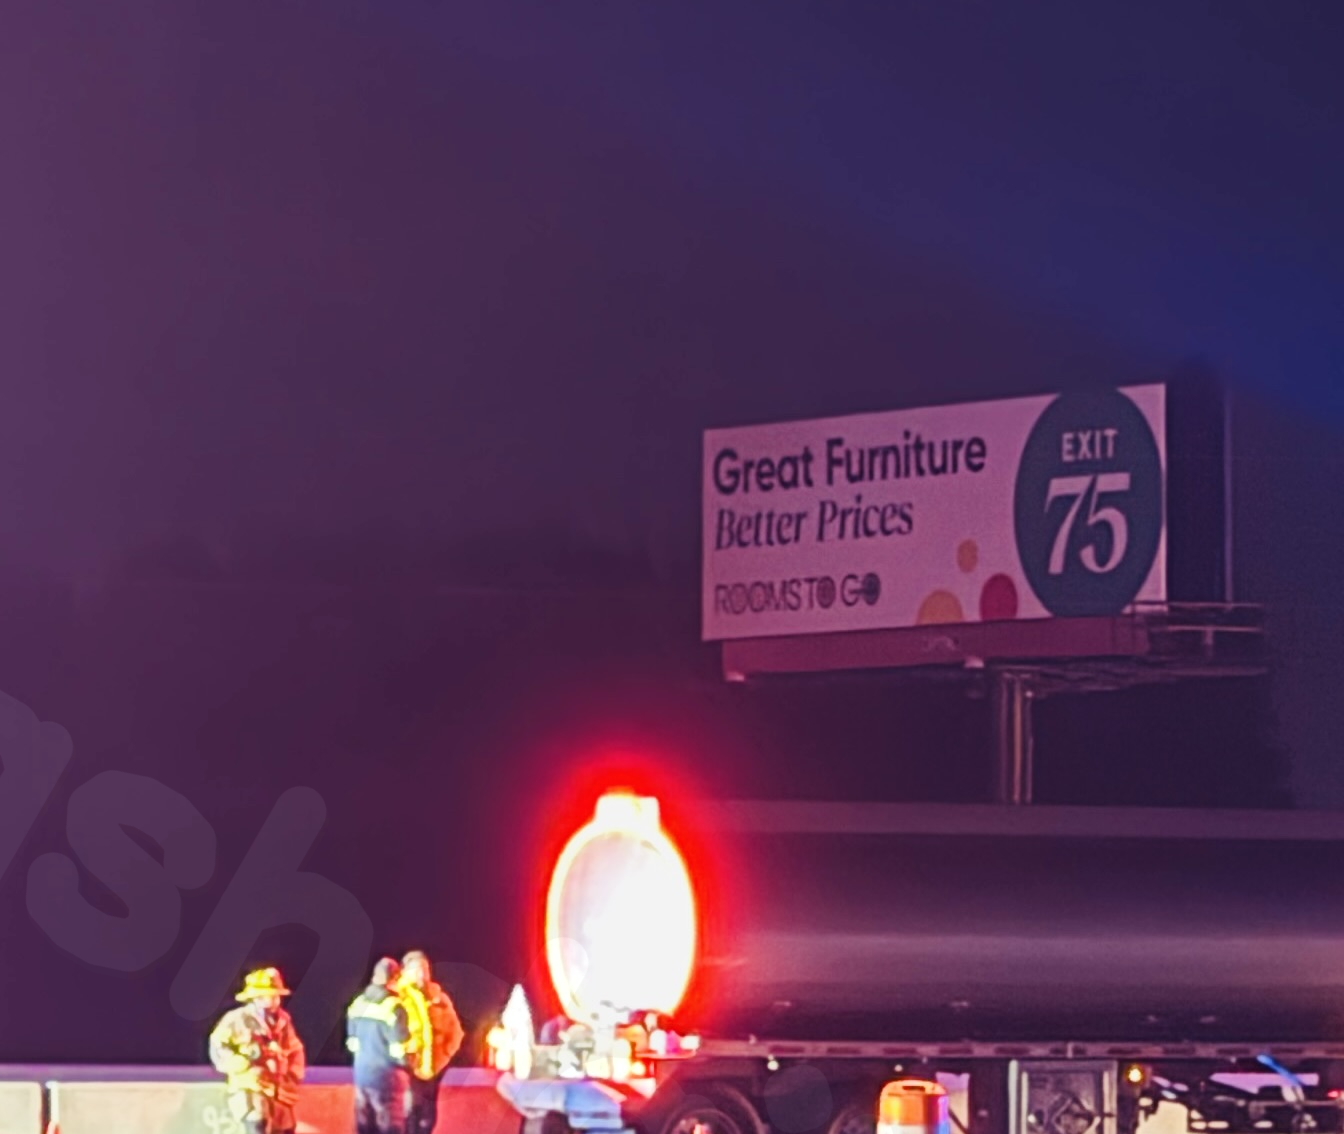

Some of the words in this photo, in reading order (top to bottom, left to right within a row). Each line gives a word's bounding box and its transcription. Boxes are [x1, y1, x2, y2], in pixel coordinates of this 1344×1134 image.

[713, 445, 813, 495] Great
[826, 430, 987, 485] Furniture
[1062, 429, 1118, 461] EXIT
[714, 507, 808, 550] Better
[816, 495, 914, 541] Prices
[1044, 473, 1131, 574] 75
[714, 579, 802, 615] ROOMS
[804, 575, 837, 609] TO
[841, 572, 881, 607] GO
